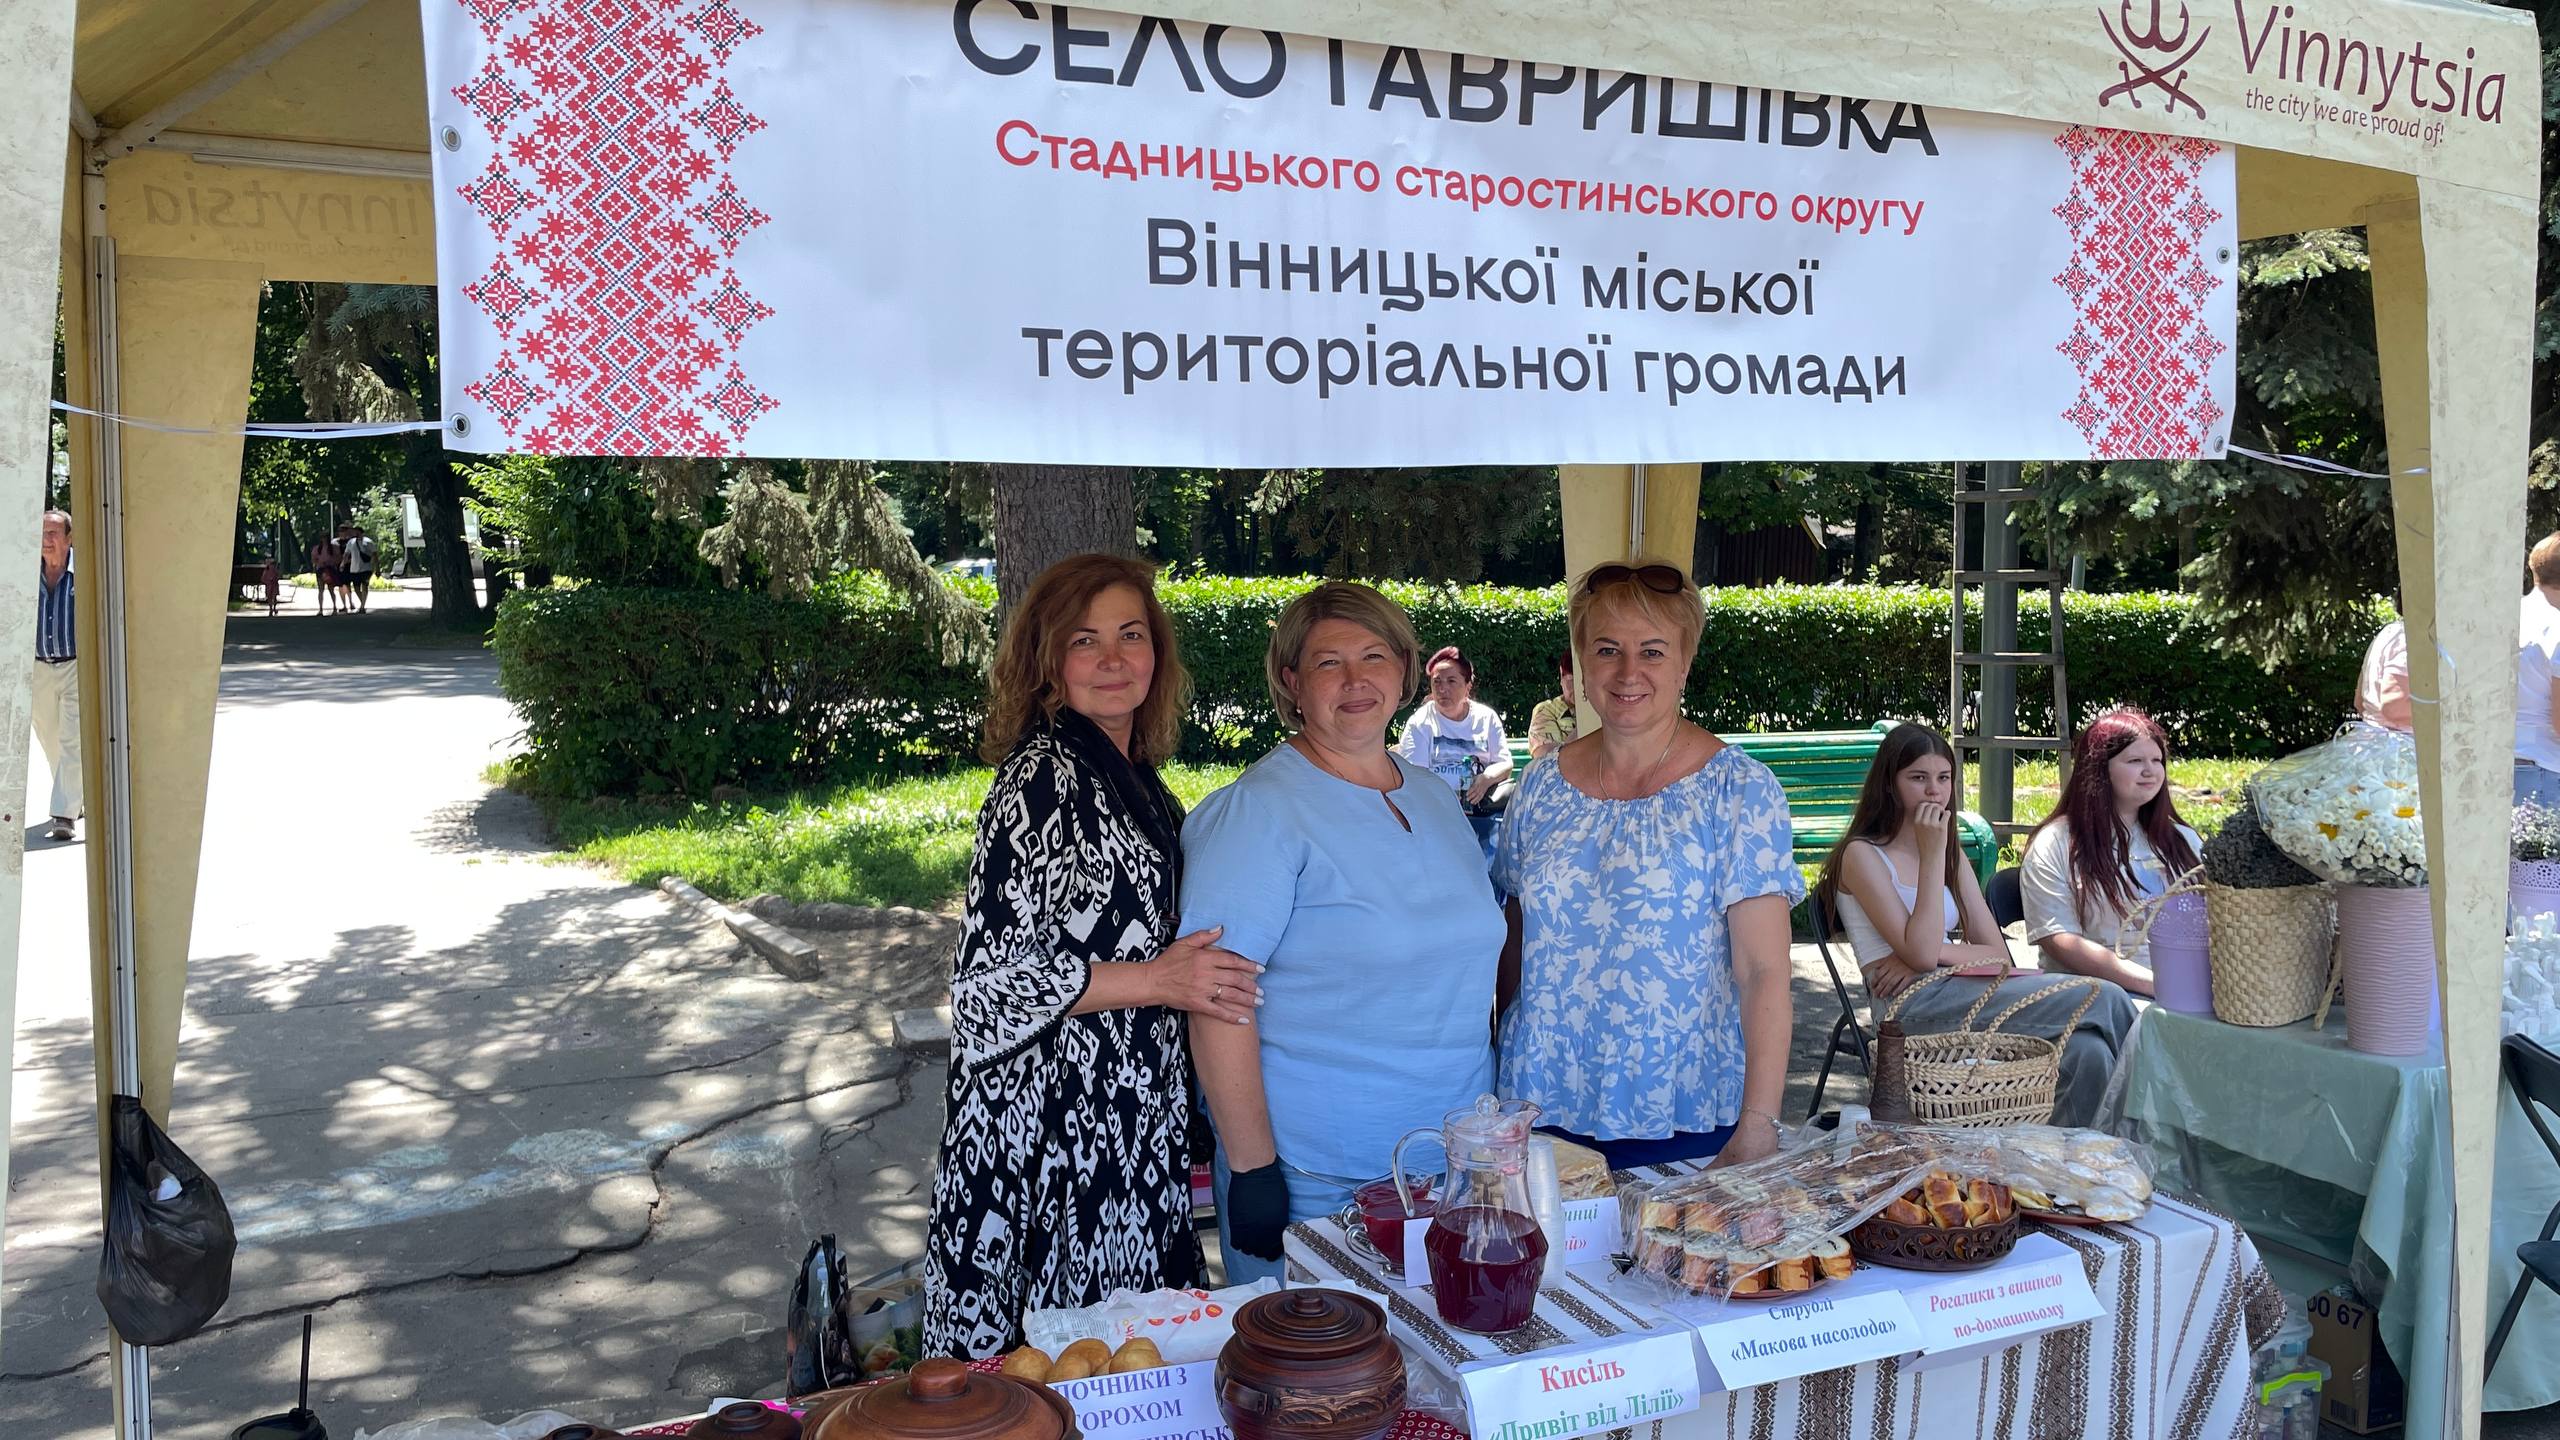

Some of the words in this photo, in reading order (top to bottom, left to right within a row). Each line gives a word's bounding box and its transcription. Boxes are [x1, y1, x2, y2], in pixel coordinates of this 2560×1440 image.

[953, 0, 1287, 99] СЕЛО
[2234, 0, 2506, 124] Vinnytsia
[2246, 87, 2274, 111] the
[2278, 93, 2310, 121] city
[2313, 102, 2338, 122] we
[2343, 109, 2368, 127] are
[2371, 115, 2421, 138] proud
[2424, 121, 2444, 146] of!
[996, 119, 1380, 192] Стадницького
[1396, 162, 1777, 221] старостинського
[1791, 194, 1925, 236] округу
[1147, 218, 1559, 312] Вінницької
[1583, 251, 1820, 315] міської
[1021, 323, 1611, 400] територіальної
[1635, 350, 1907, 406] громади
[1929, 1287, 1995, 1313] Рогалики
[1998, 1285, 2005, 1298] з
[2008, 1273, 2063, 1295] вишнею
[2337, 1303, 2364, 1330] 67
[1731, 1334, 1808, 1362] «Макова
[1811, 1318, 1897, 1347] насолода»
[1953, 1304, 2064, 1338] по-домашньому
[1538, 1358, 1625, 1393] Кисіль
[1075, 1399, 1184, 1431] ОРОХОМ
[1490, 1410, 1580, 1440] «Привіт
[1585, 1403, 1618, 1426] від
[1624, 1388, 1684, 1420] Лілії»
